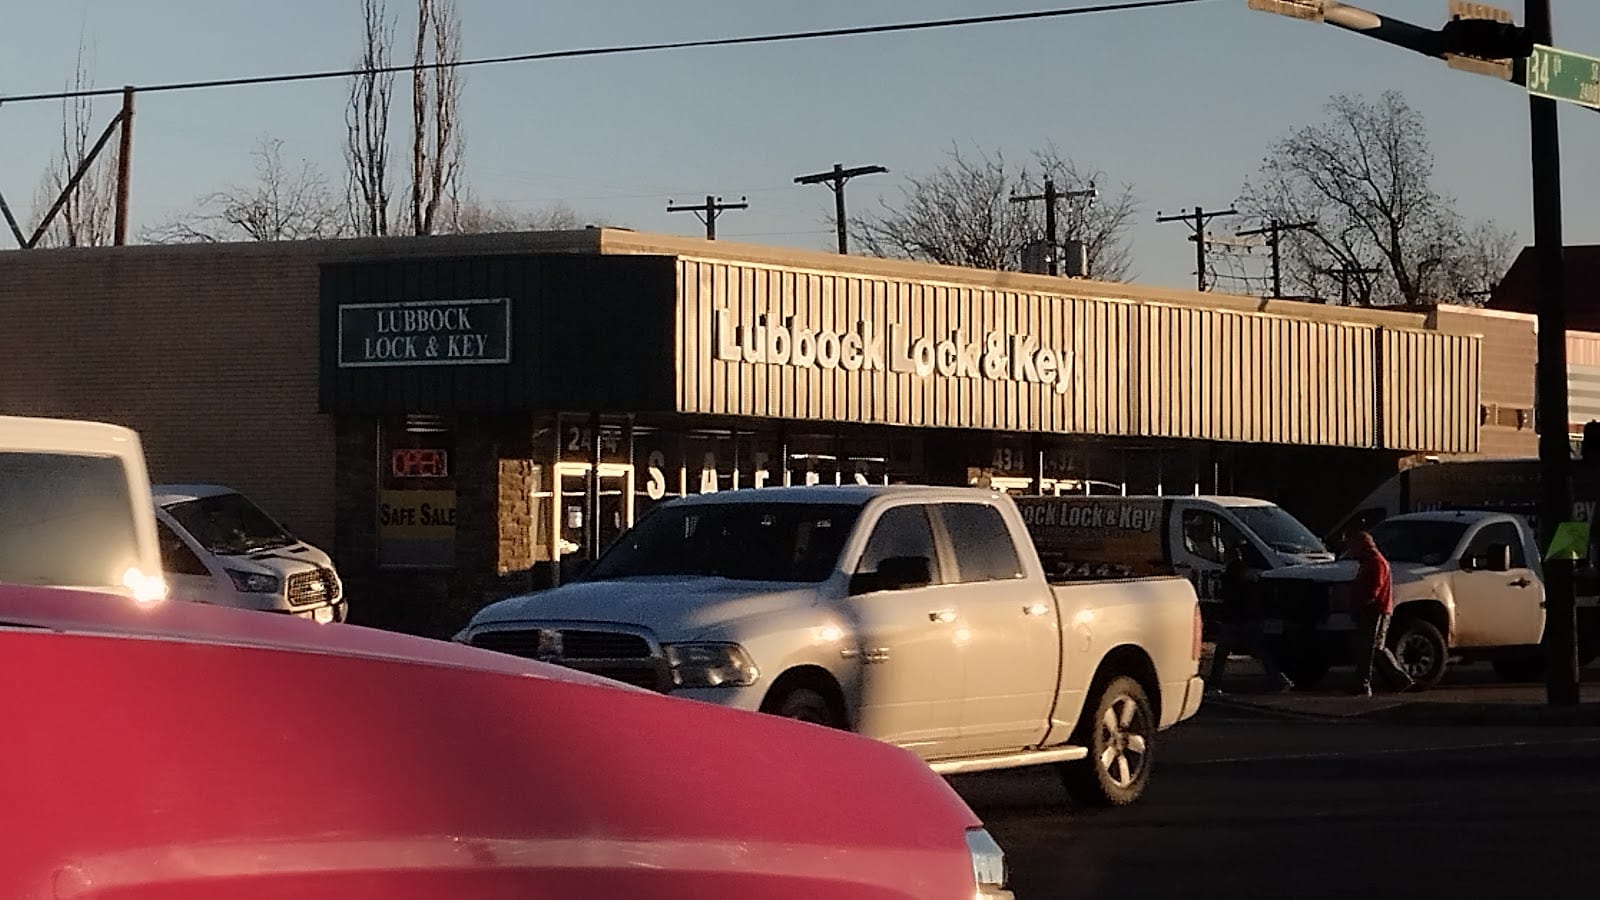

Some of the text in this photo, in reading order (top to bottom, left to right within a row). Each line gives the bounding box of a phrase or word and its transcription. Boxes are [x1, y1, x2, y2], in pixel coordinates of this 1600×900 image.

[378, 307, 471, 333] LUBBOCK
[365, 334, 488, 360] LOCK & KEY
[714, 308, 1074, 395] Lubbock Lock & Key
[1060, 502, 1104, 528] Lock
[1119, 506, 1155, 533] Key
